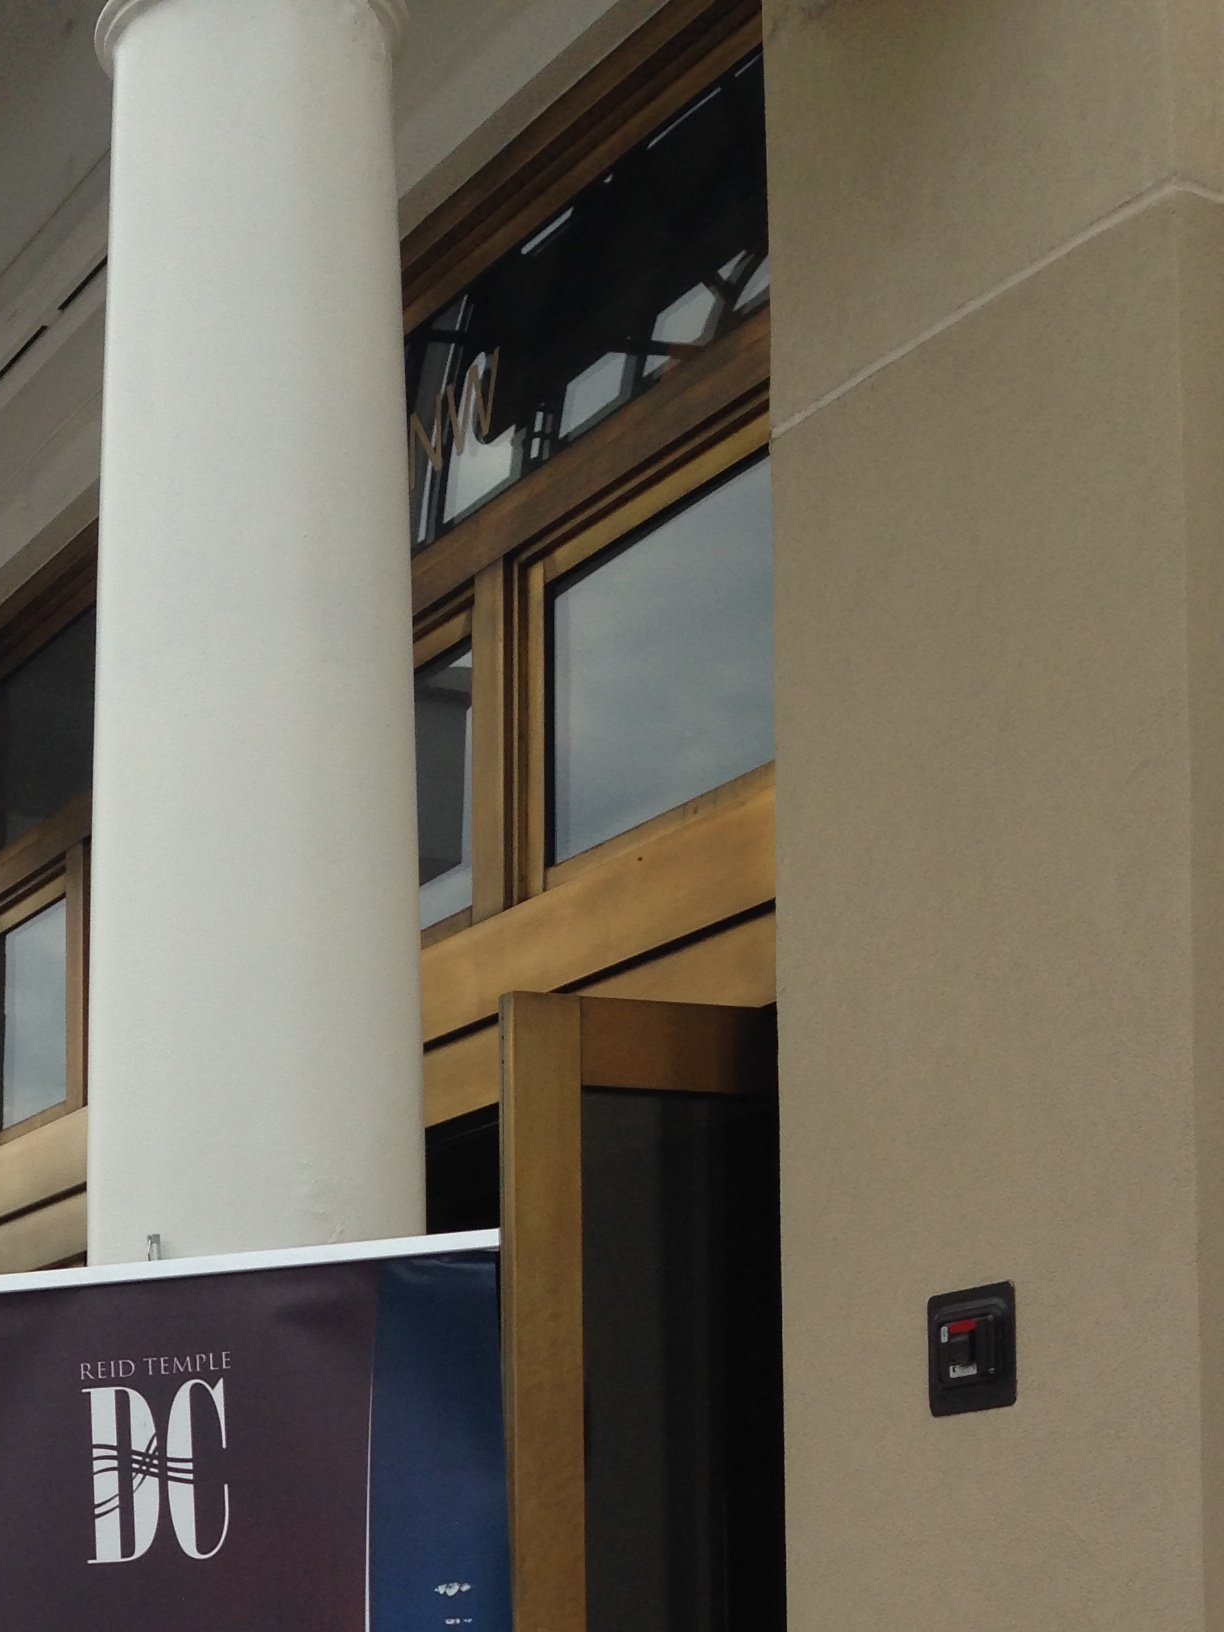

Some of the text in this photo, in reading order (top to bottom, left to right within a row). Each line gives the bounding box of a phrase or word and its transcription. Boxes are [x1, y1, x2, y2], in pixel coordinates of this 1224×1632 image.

[79, 1350, 232, 1380] REID TEMPLE
[81, 1375, 231, 1565] DC
